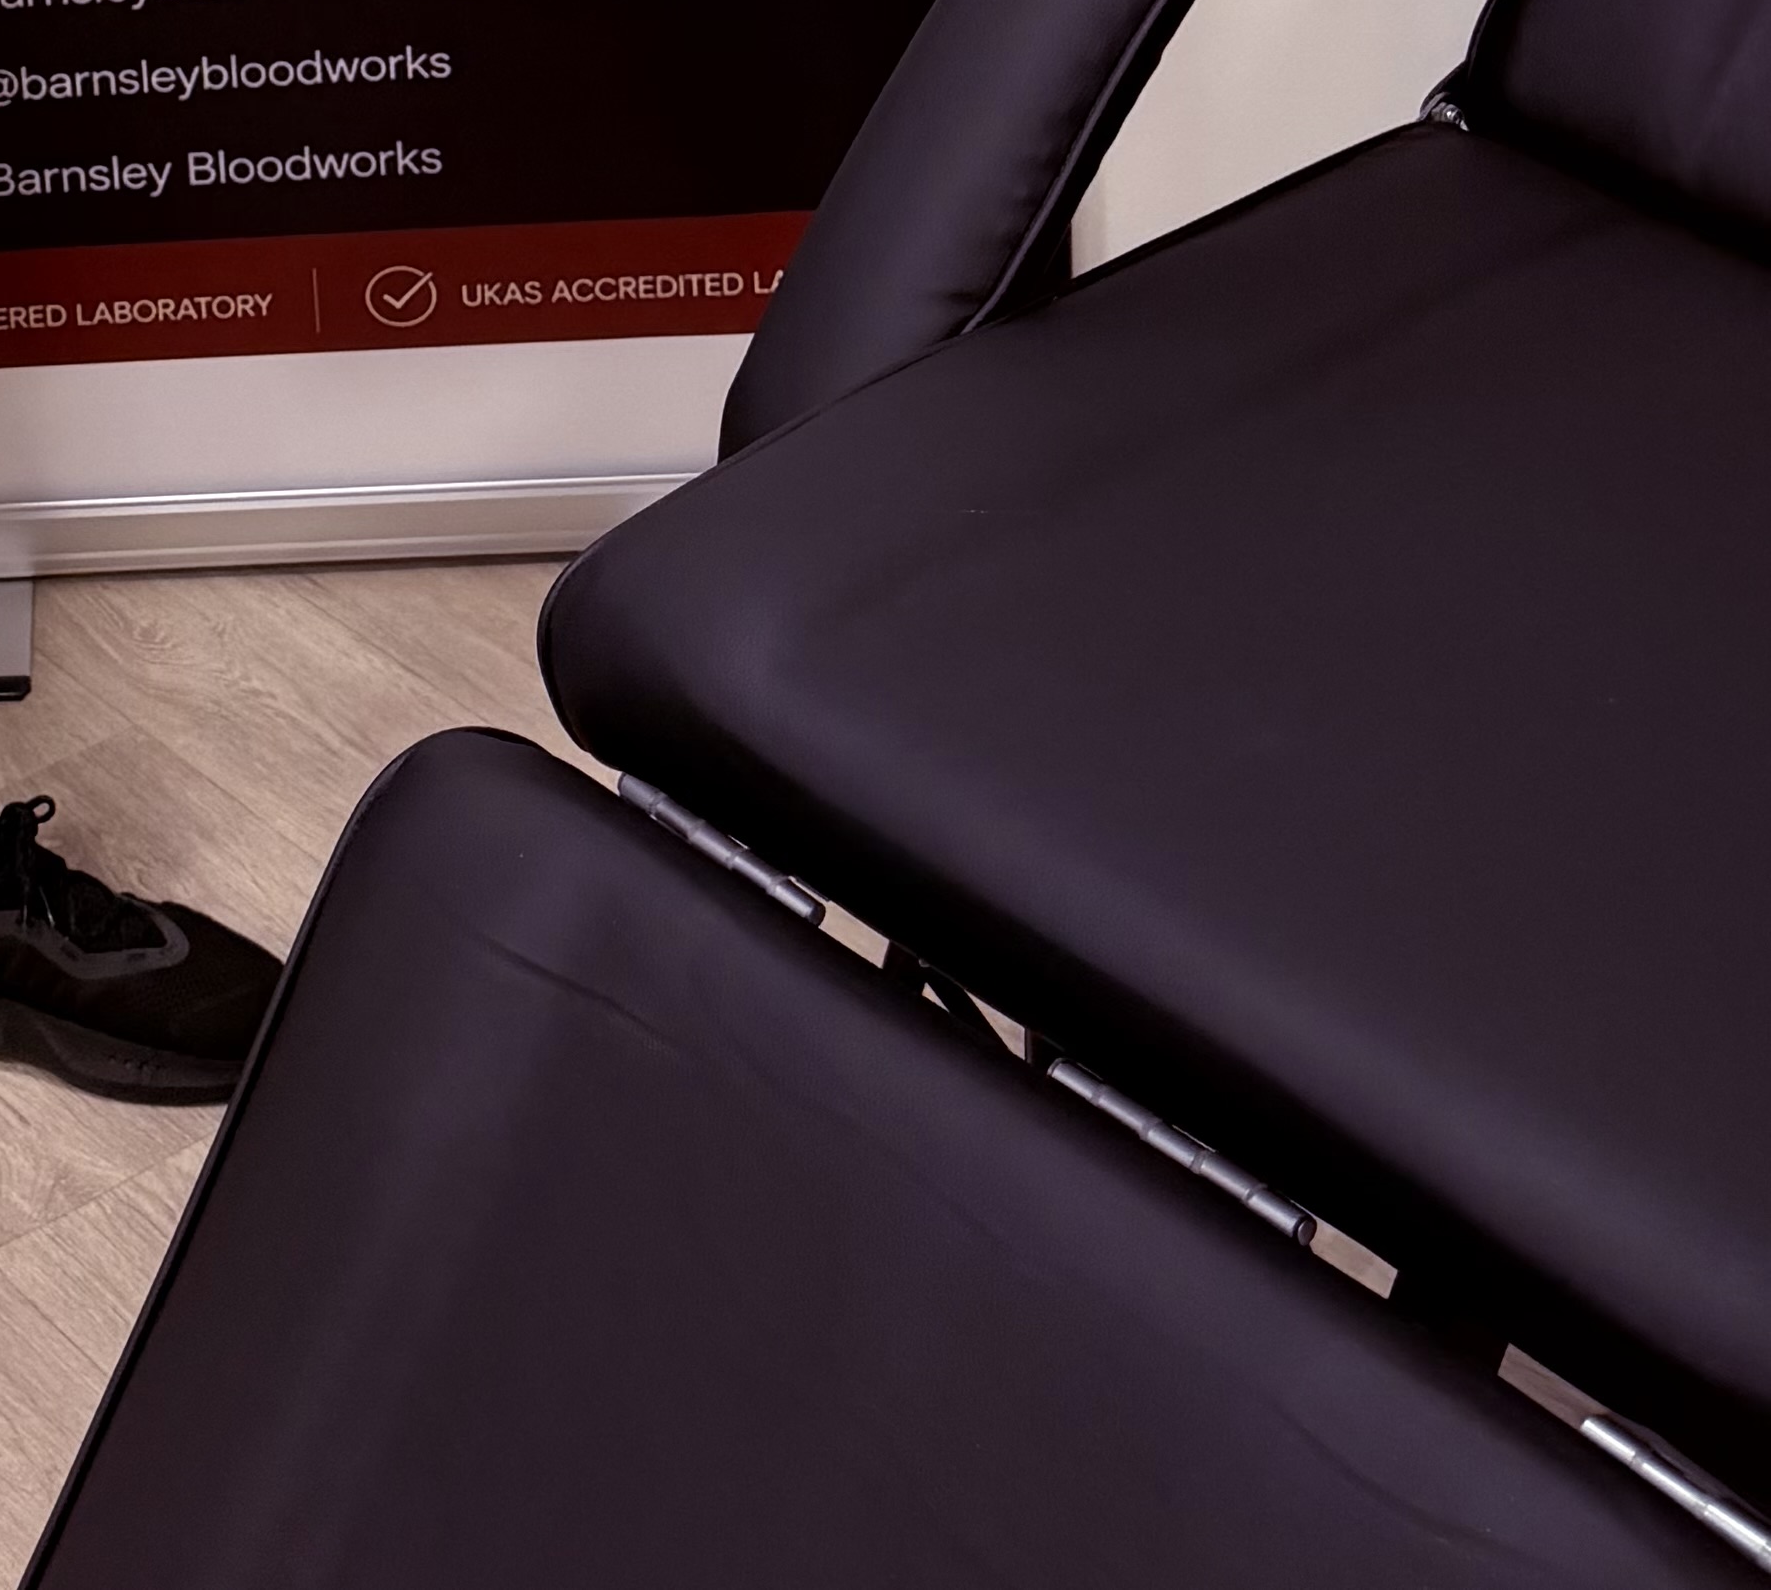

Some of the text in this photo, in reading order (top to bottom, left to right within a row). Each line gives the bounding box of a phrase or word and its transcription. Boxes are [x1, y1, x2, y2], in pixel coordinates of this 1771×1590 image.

[188, 141, 442, 185] Bloodworks
[462, 281, 542, 306] UKAS
[552, 273, 743, 302] ACCREDITED
[77, 294, 272, 325] LABORATORY
